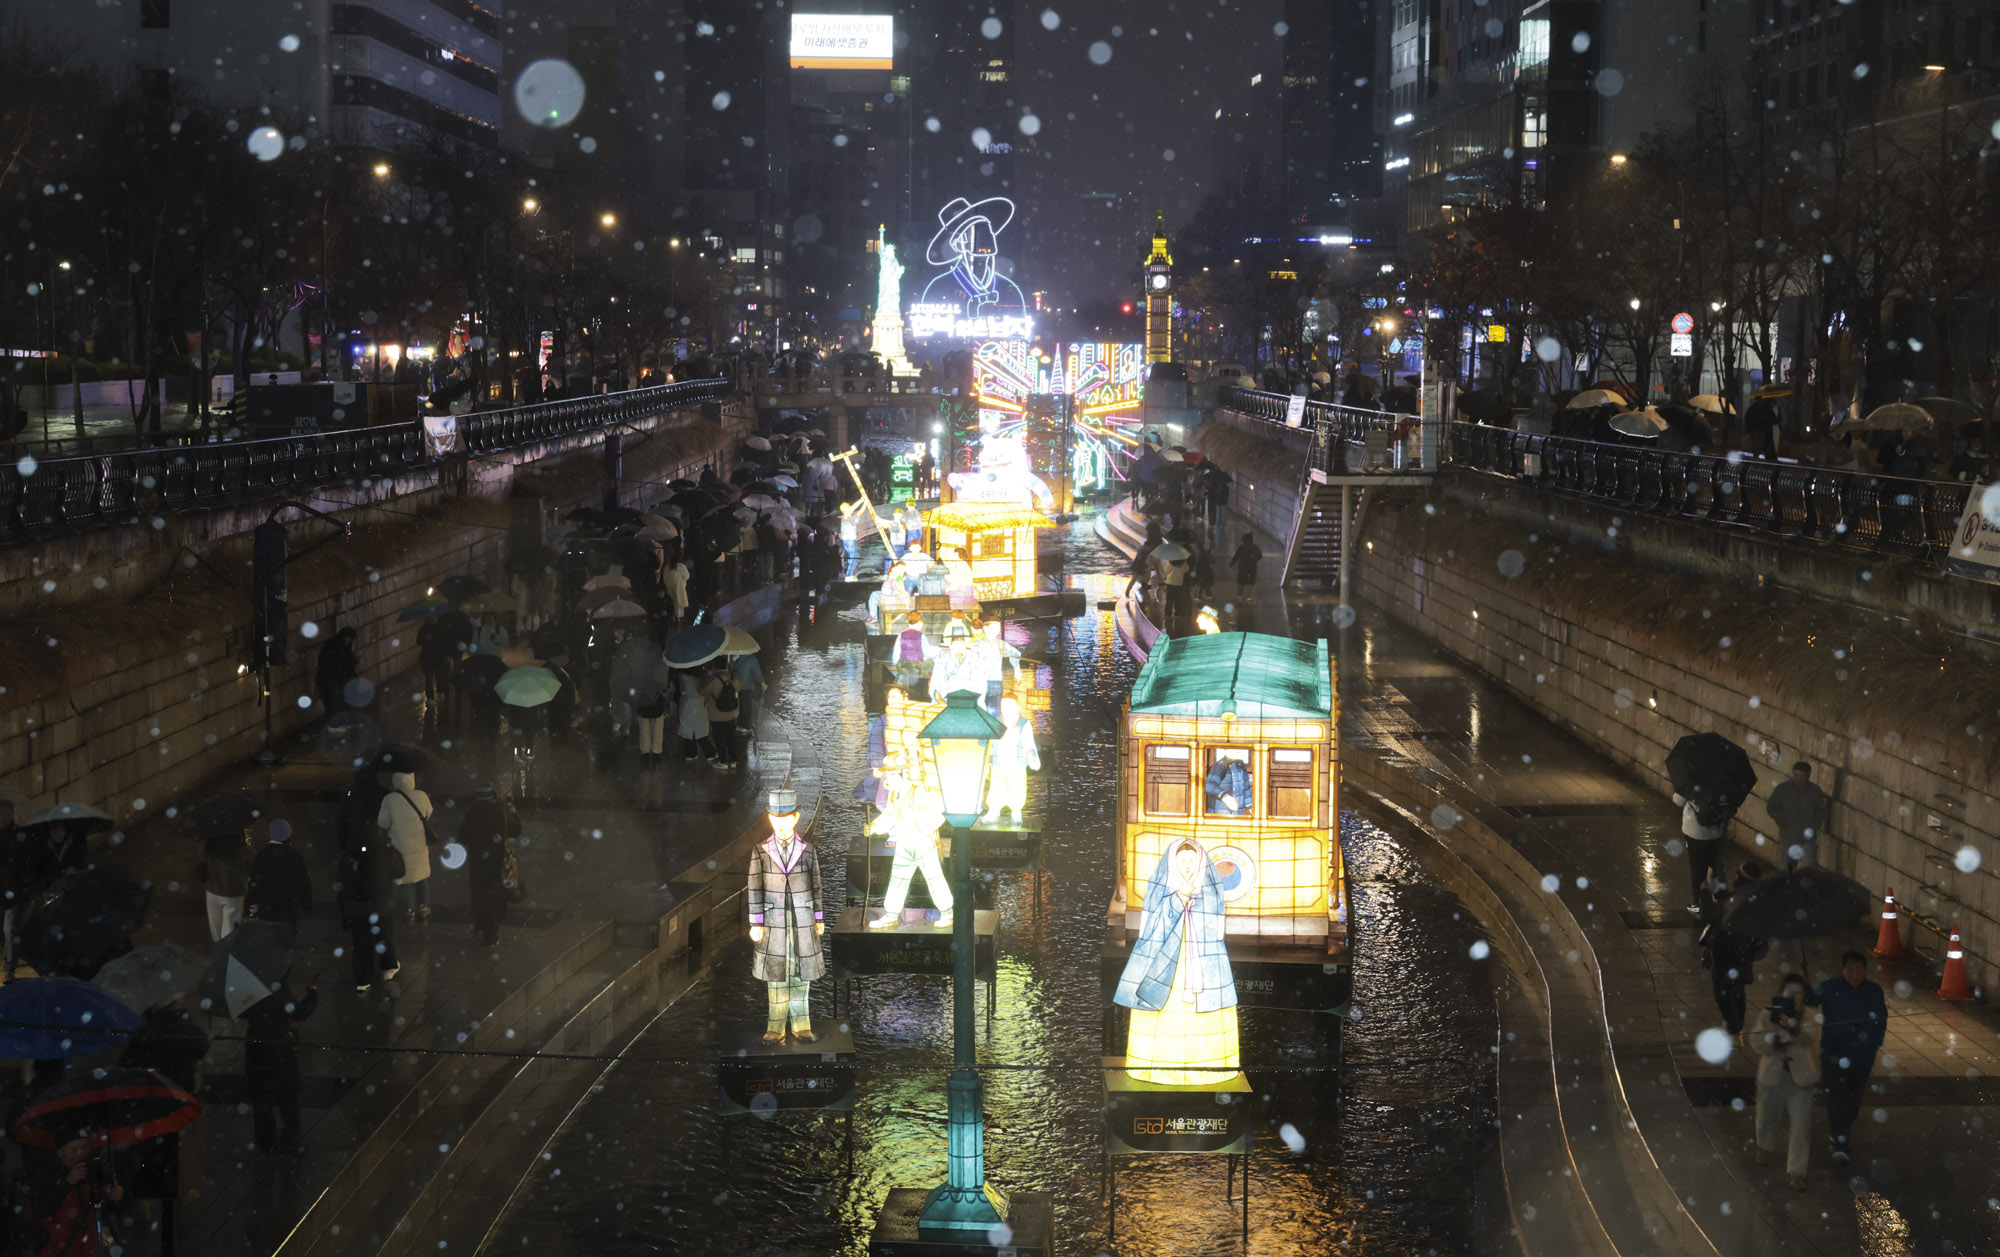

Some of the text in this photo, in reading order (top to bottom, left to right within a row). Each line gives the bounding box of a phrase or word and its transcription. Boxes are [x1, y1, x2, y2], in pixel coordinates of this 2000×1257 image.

[804, 37, 868, 48] 미래에셋증권
[910, 304, 961, 314] MUSICAL
[1165, 1118, 1228, 1130] 서울관광재단
